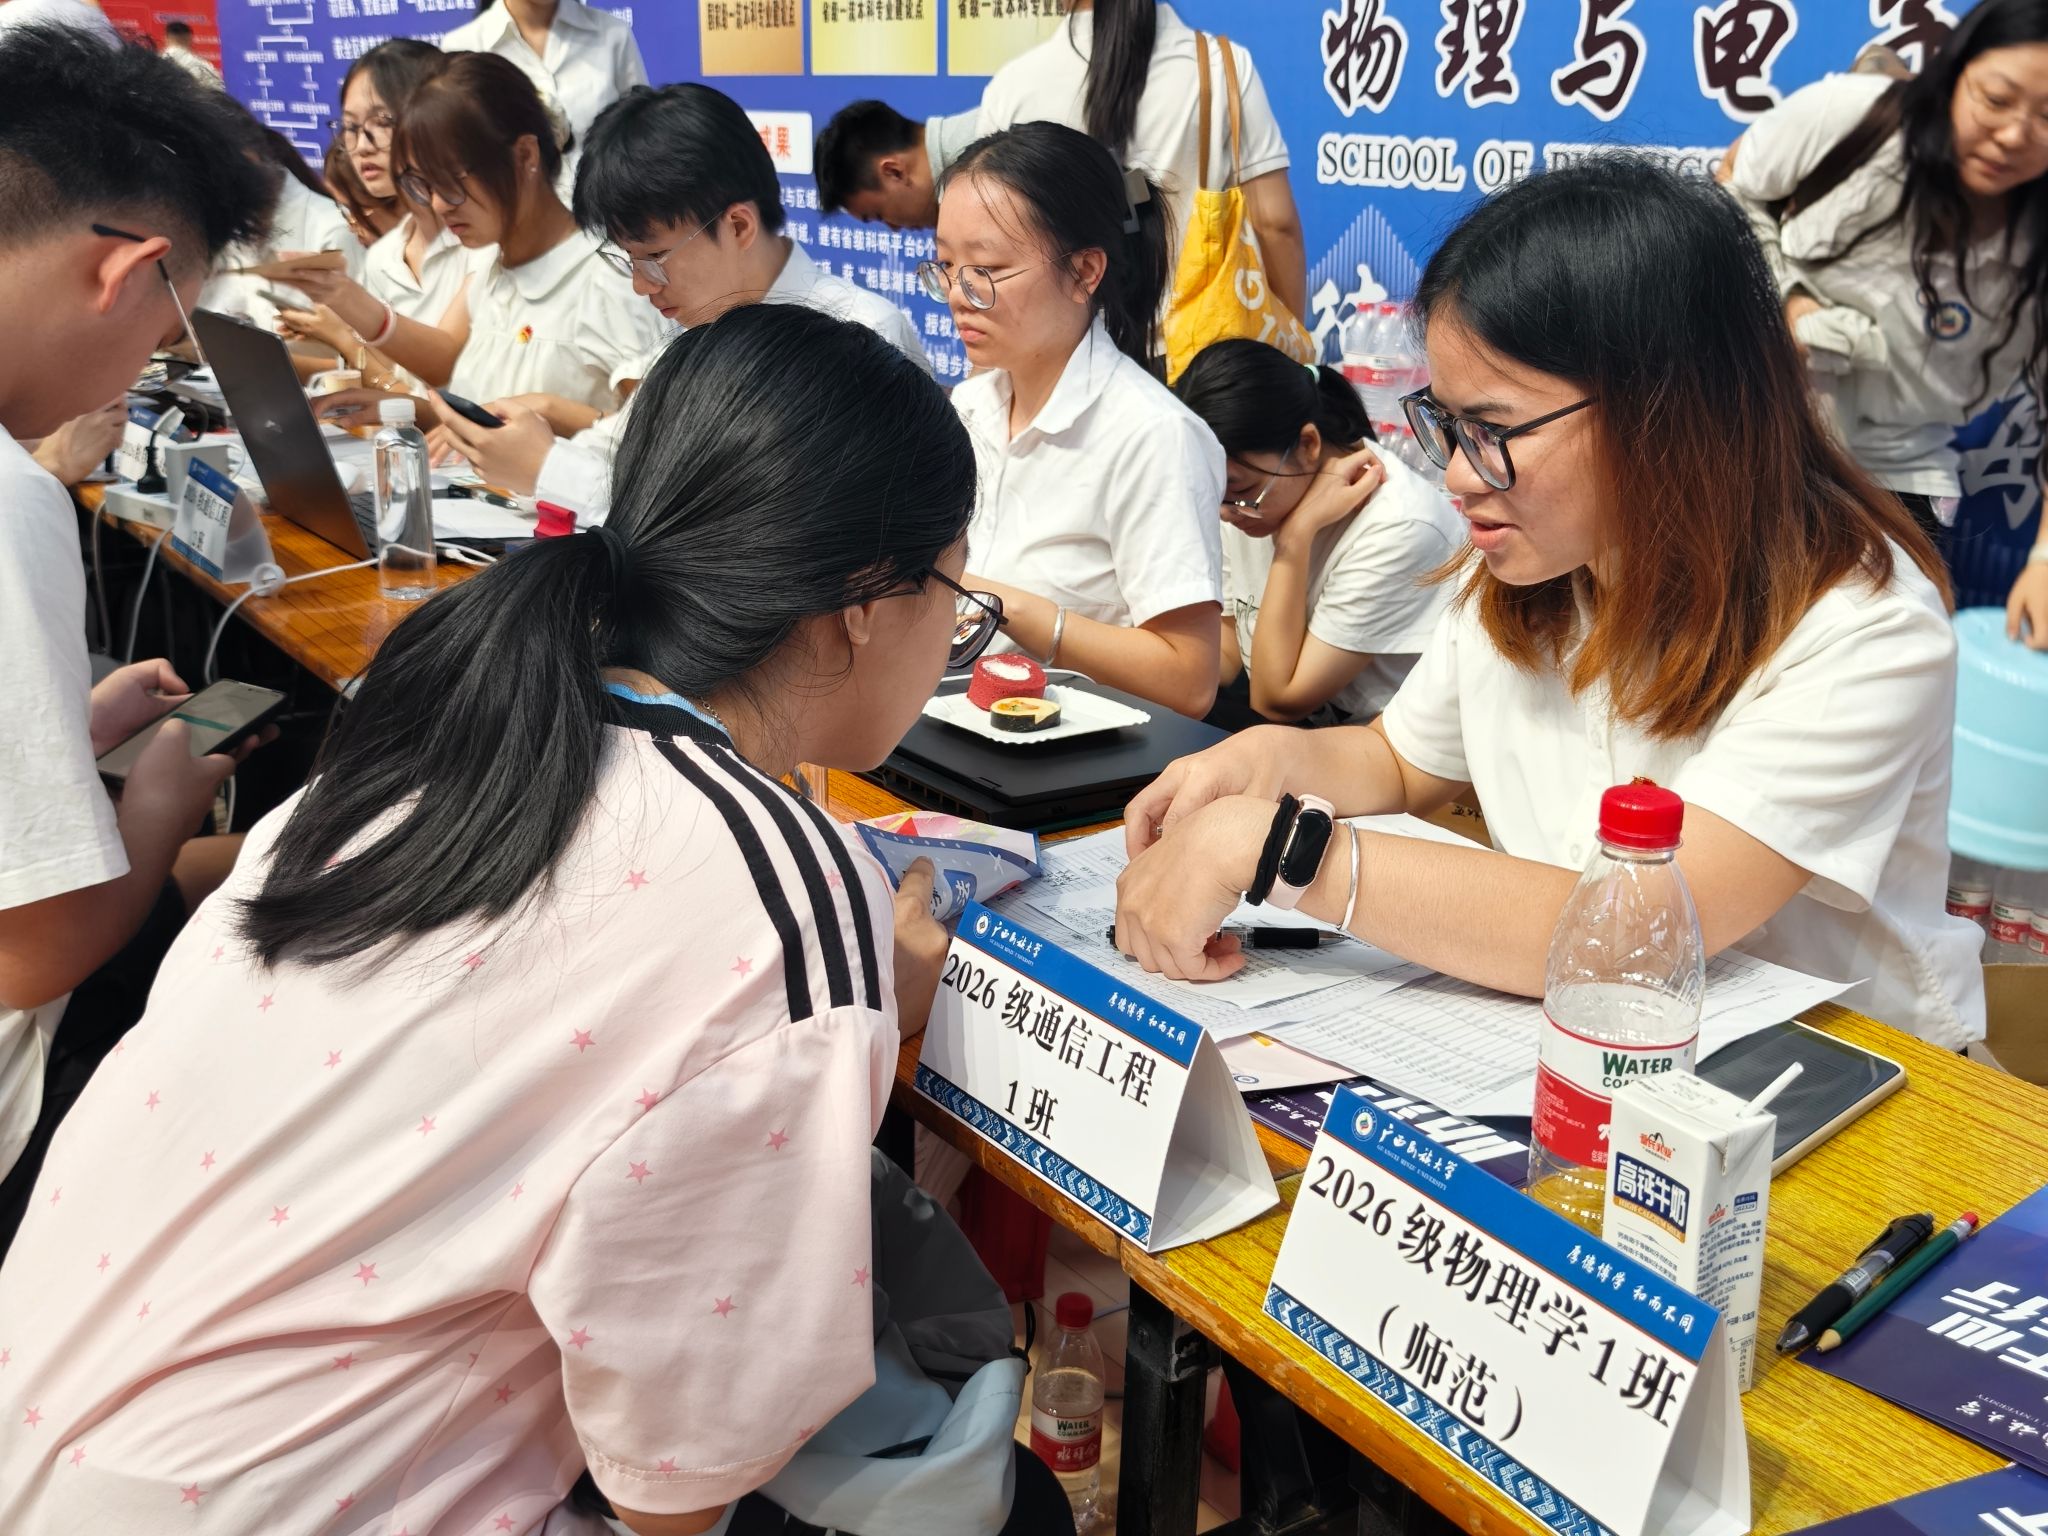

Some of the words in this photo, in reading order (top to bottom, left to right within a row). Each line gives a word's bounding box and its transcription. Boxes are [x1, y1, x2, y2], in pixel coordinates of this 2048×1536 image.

[1321, 140, 1461, 185] SCHOOL
[1602, 1051, 1673, 1077] WATER
[1616, 1158, 1689, 1228] 高钙牛奶
